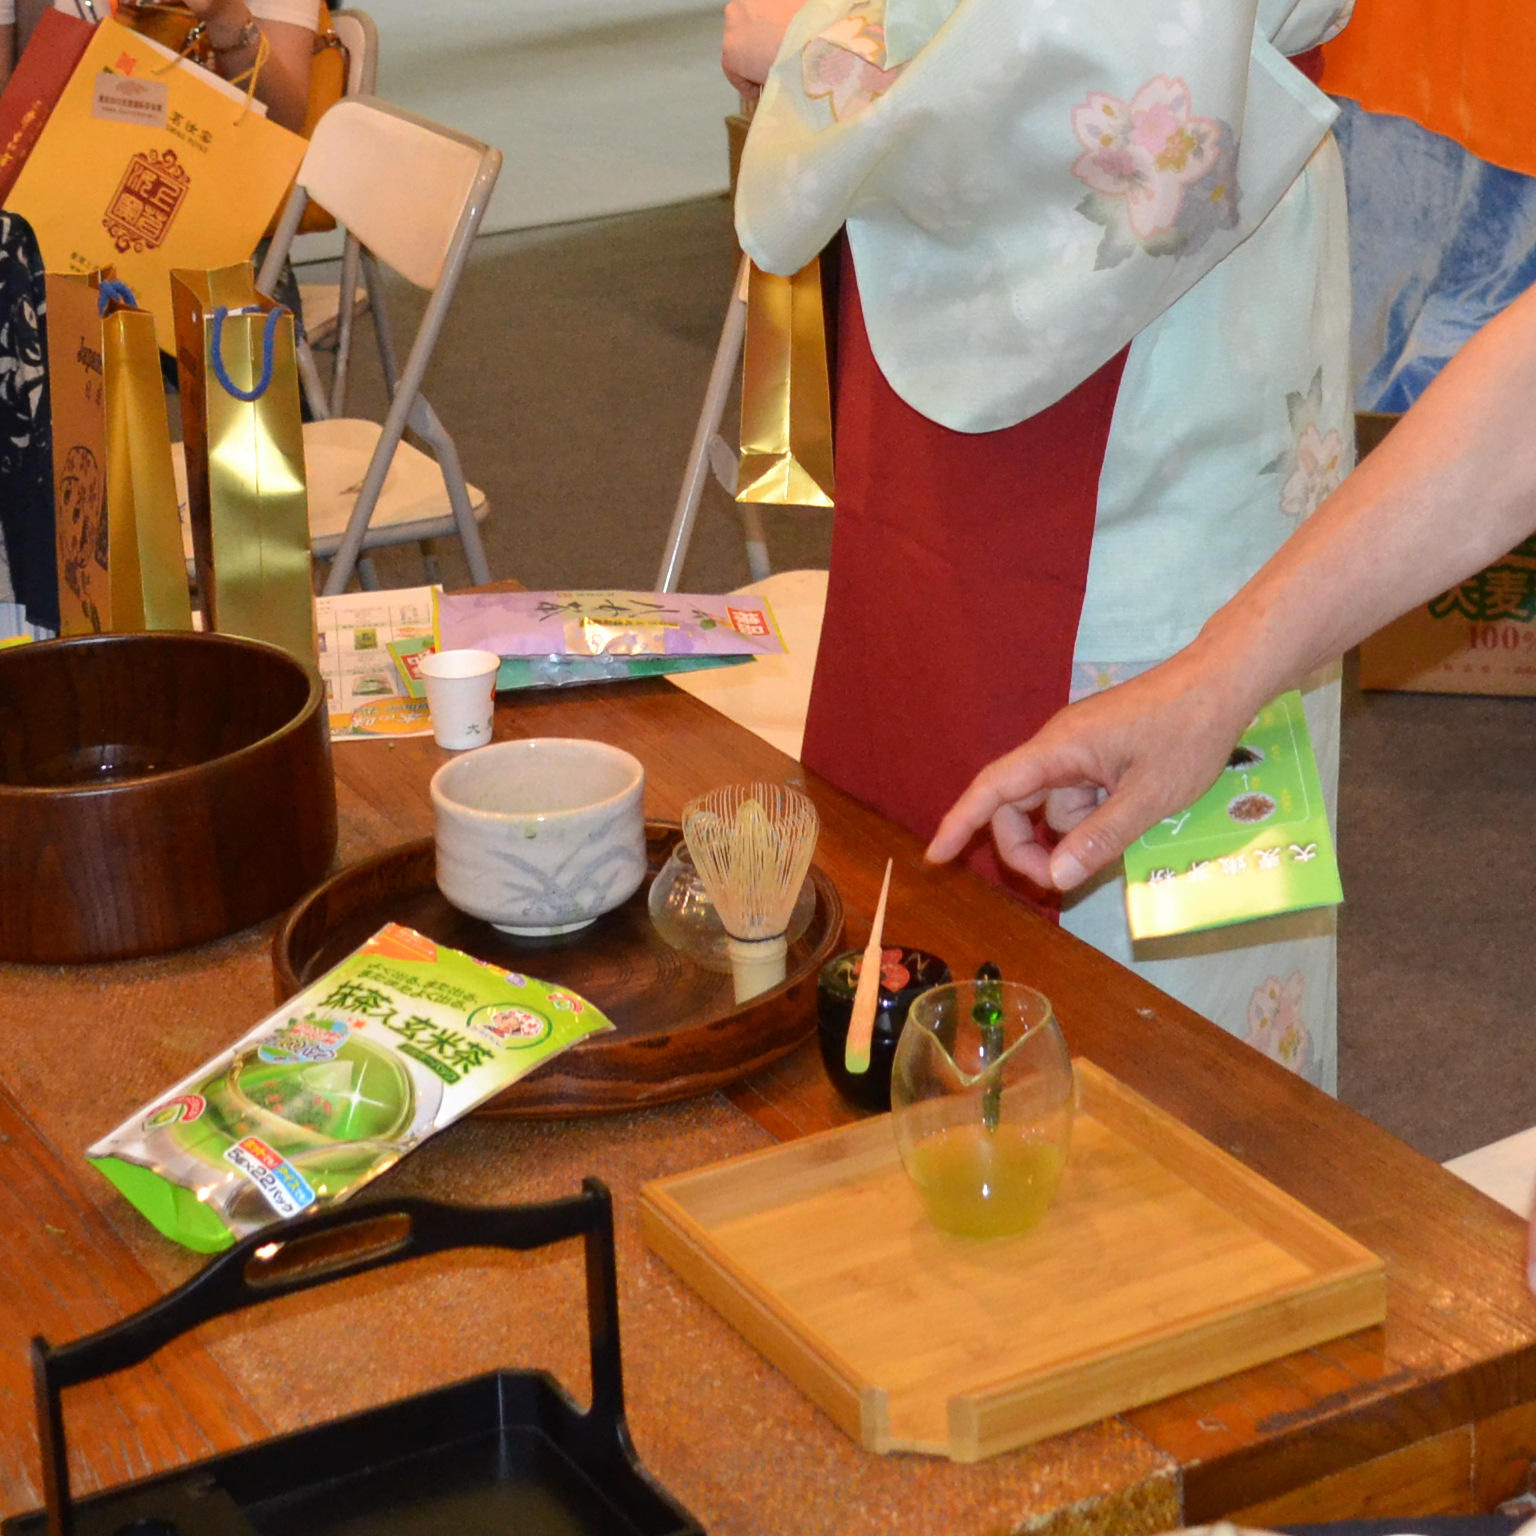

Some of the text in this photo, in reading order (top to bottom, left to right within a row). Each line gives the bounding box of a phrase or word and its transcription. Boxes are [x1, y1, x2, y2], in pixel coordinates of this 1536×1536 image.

[317, 979, 495, 1074] 抹茶入玄米茶
